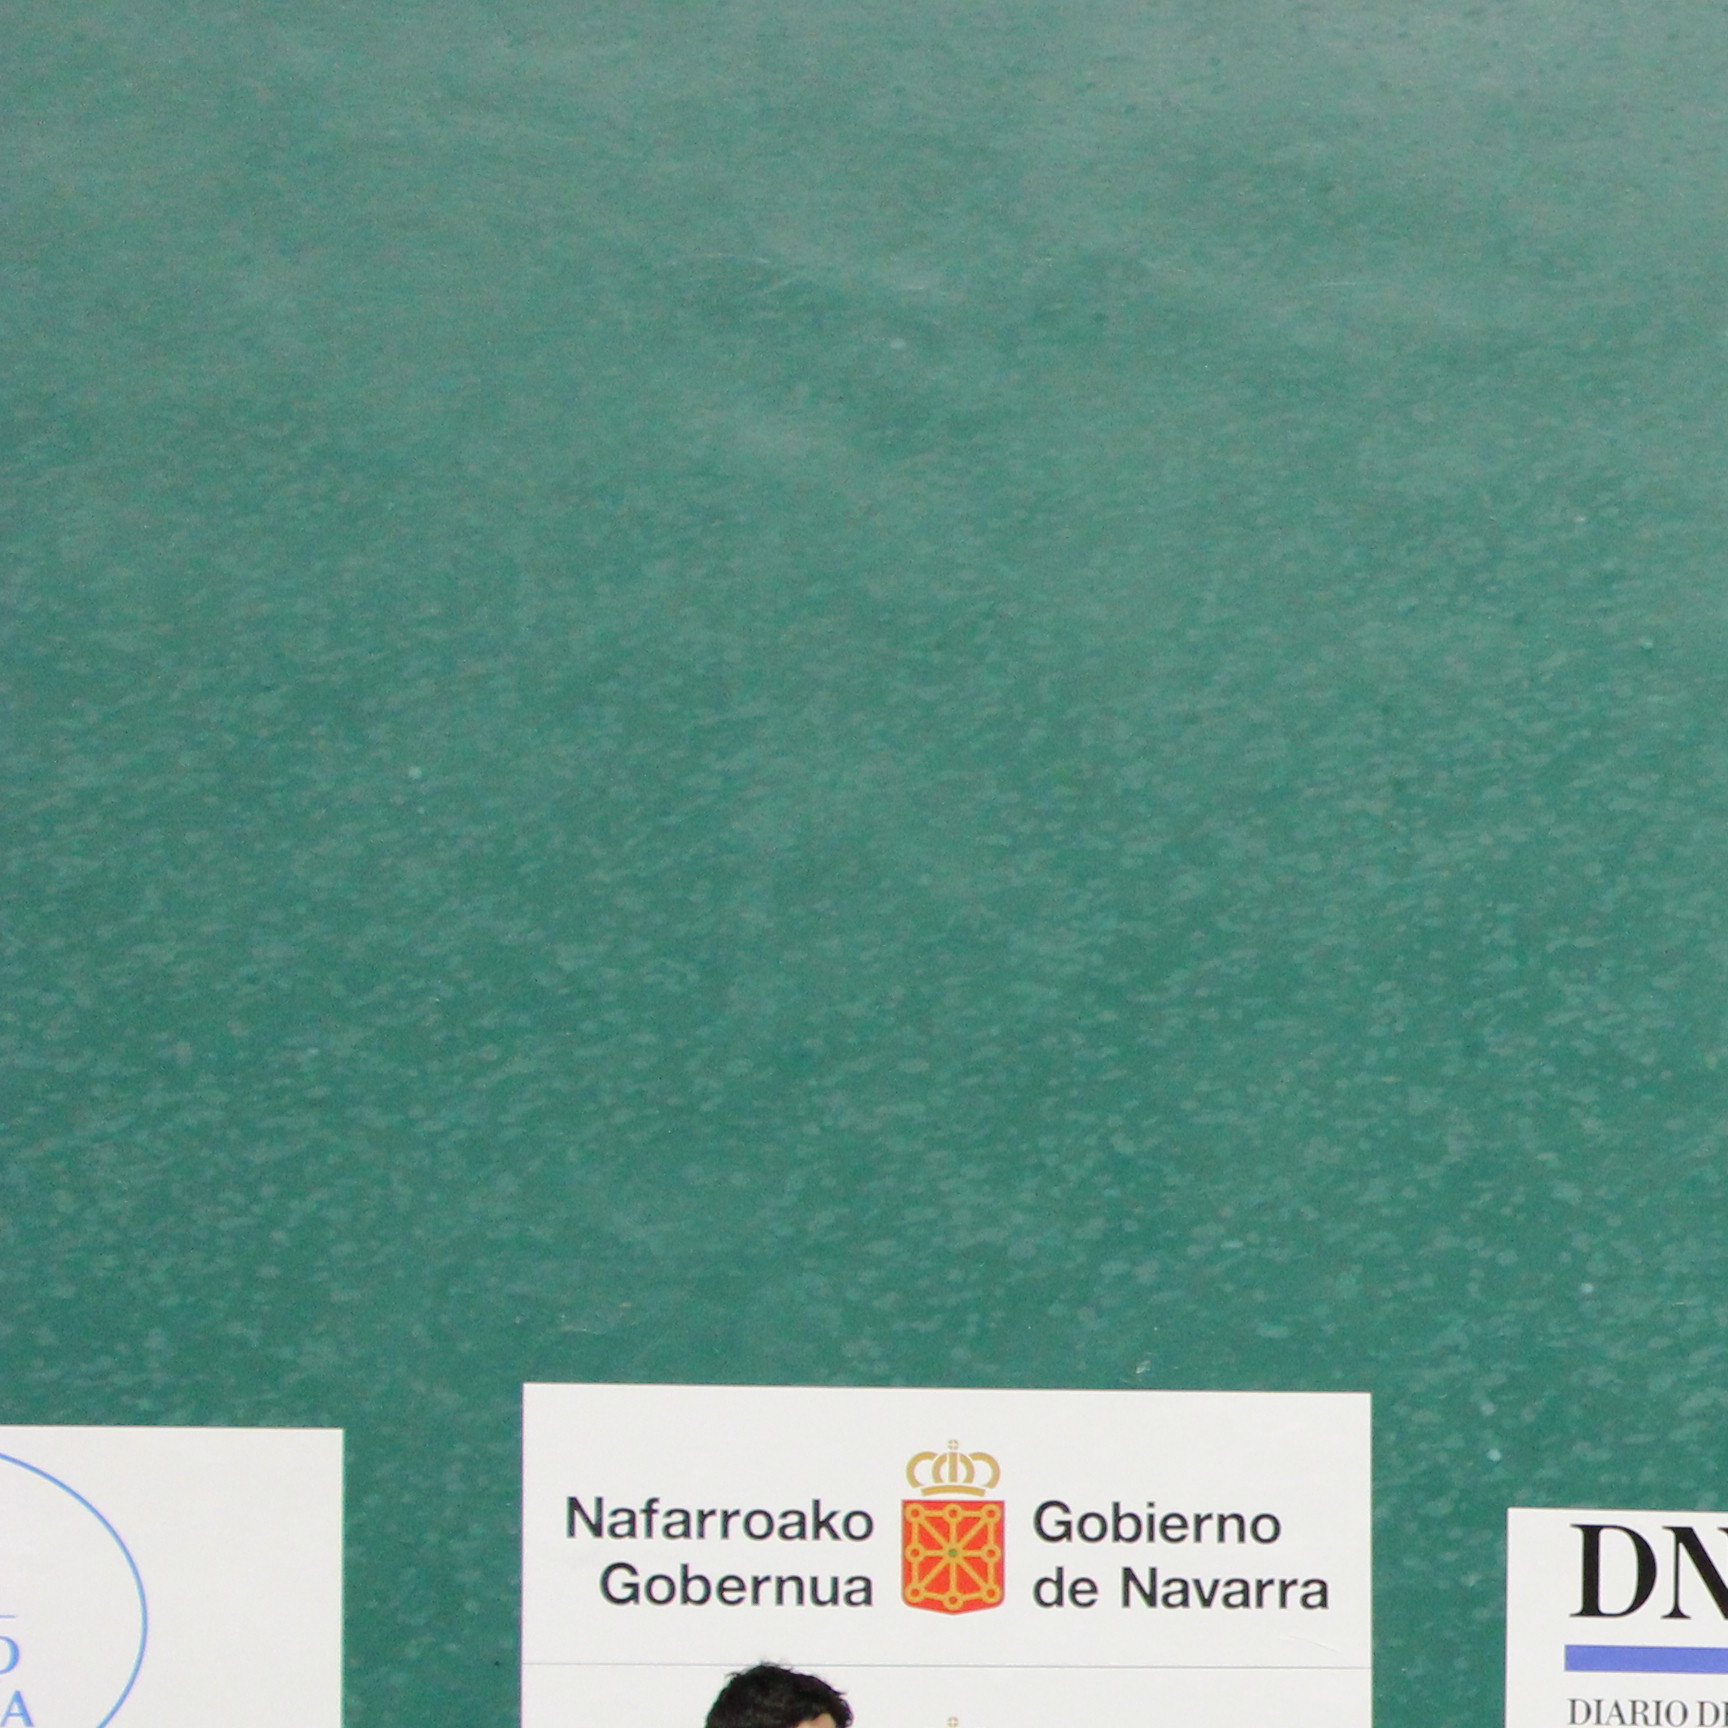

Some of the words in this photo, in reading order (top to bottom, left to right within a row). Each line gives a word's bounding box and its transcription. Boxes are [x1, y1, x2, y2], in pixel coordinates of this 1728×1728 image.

[567, 1497, 873, 1541] Nafarroako
[1034, 1500, 1281, 1544] Gobierno
[600, 1562, 872, 1607] Gobernua
[1034, 1567, 1098, 1608] de
[1122, 1567, 1328, 1609] Navarra
[1570, 1699, 1688, 1726] DIARIO
